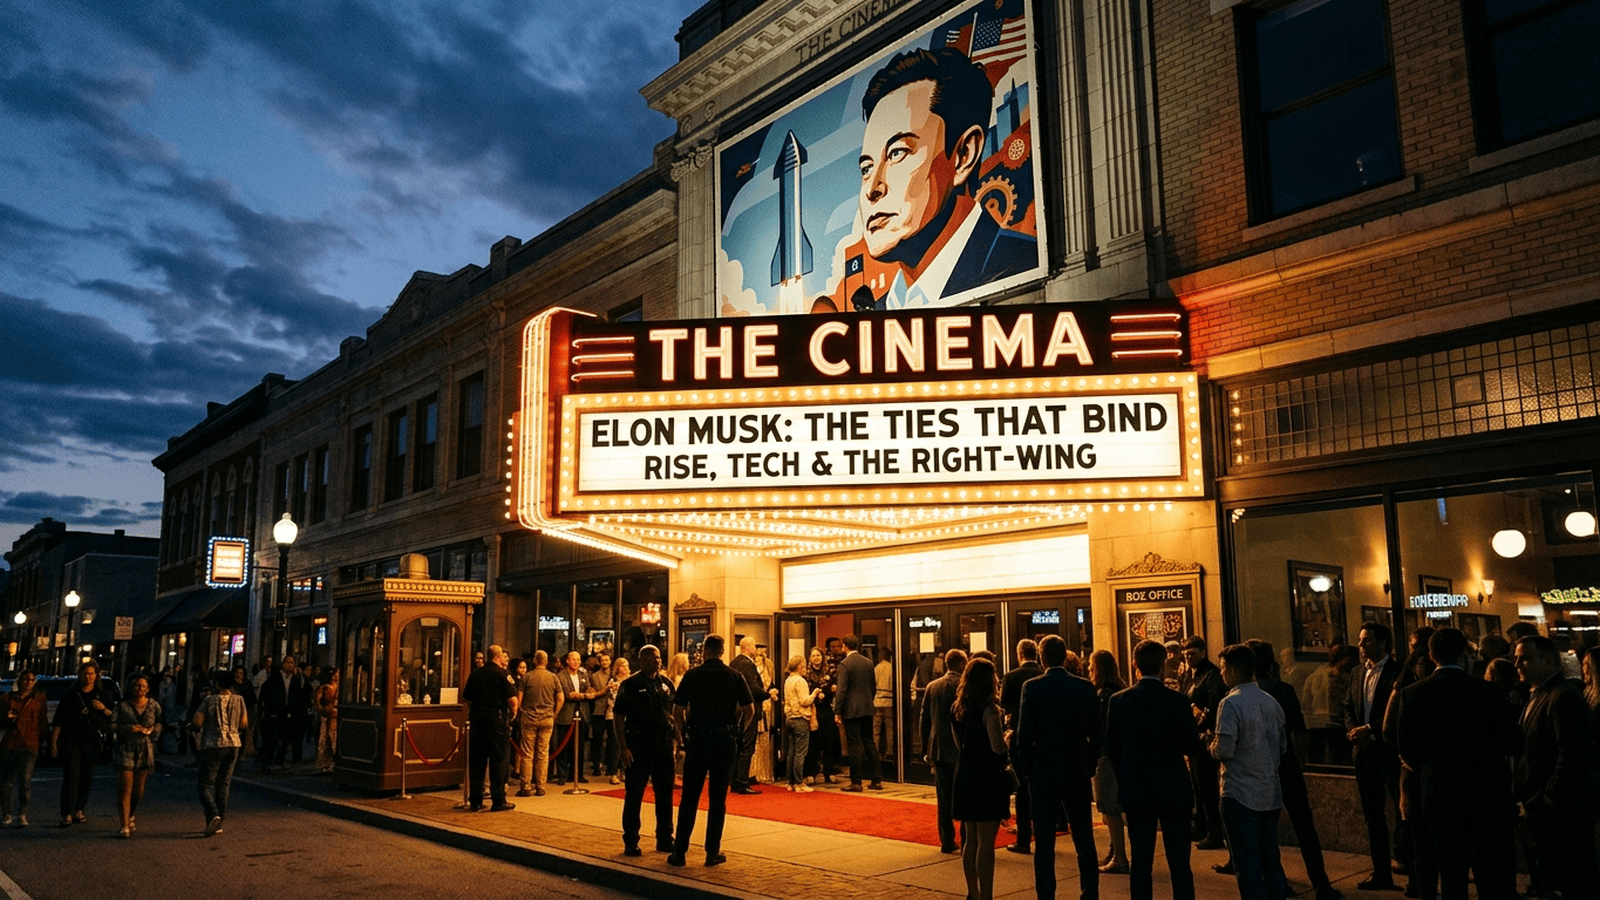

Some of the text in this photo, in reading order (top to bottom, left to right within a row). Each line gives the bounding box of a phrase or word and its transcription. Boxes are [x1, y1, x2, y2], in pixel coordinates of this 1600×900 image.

[795, 28, 832, 64] THE
[648, 311, 1094, 382] THE CINEMA
[592, 402, 1168, 448] ELON MUSK: THE TIES THAT BIND
[644, 443, 1097, 481] RISE, TECH & THE RIGHT-WING
[1148, 588, 1184, 600] OFFICE
